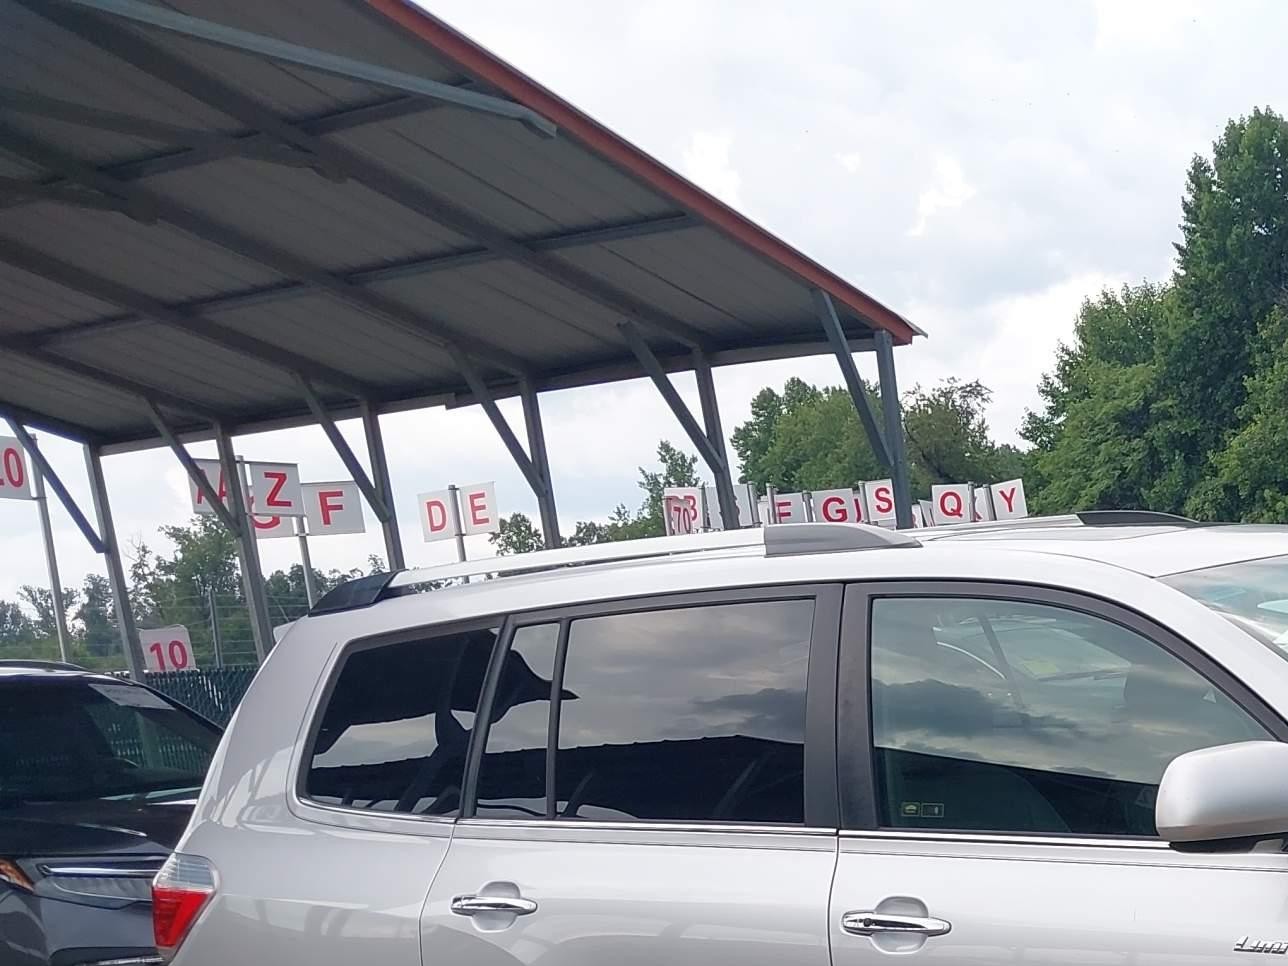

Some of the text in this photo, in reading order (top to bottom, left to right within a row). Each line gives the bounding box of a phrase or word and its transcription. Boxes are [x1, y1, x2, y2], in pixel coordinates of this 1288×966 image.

[264, 472, 292, 507] Z
[874, 487, 893, 513] S
[940, 491, 963, 518] Q
[999, 487, 1016, 513] Y
[318, 491, 343, 525] F
[426, 500, 447, 532] D
[469, 492, 490, 525] E
[822, 496, 848, 523] G
[150, 640, 188, 672] 10
